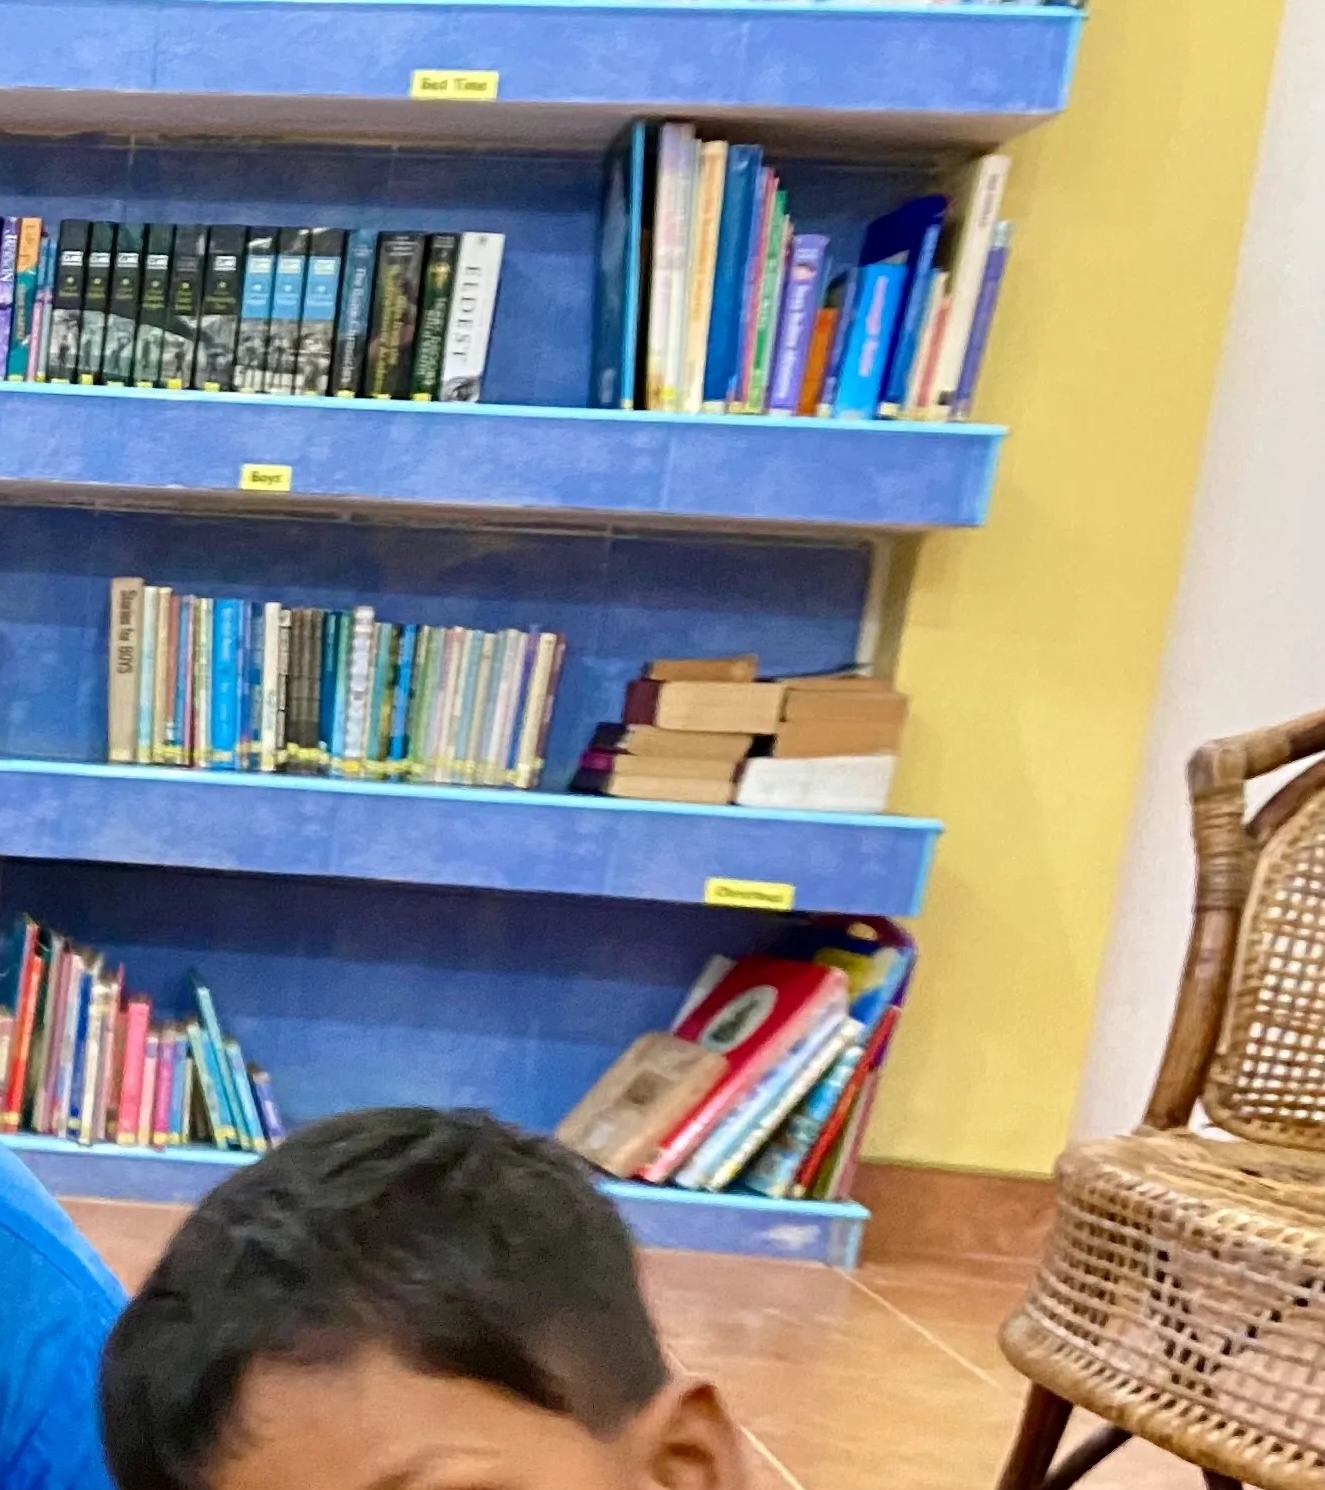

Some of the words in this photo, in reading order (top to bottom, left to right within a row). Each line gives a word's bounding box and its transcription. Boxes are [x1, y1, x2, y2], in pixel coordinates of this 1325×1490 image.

[454, 78, 488, 92] Time
[452, 266, 481, 363] ELDEST
[251, 472, 282, 484] Boys
[120, 590, 137, 625] Stories
[119, 628, 134, 642] for
[116, 645, 134, 675] BOYS
